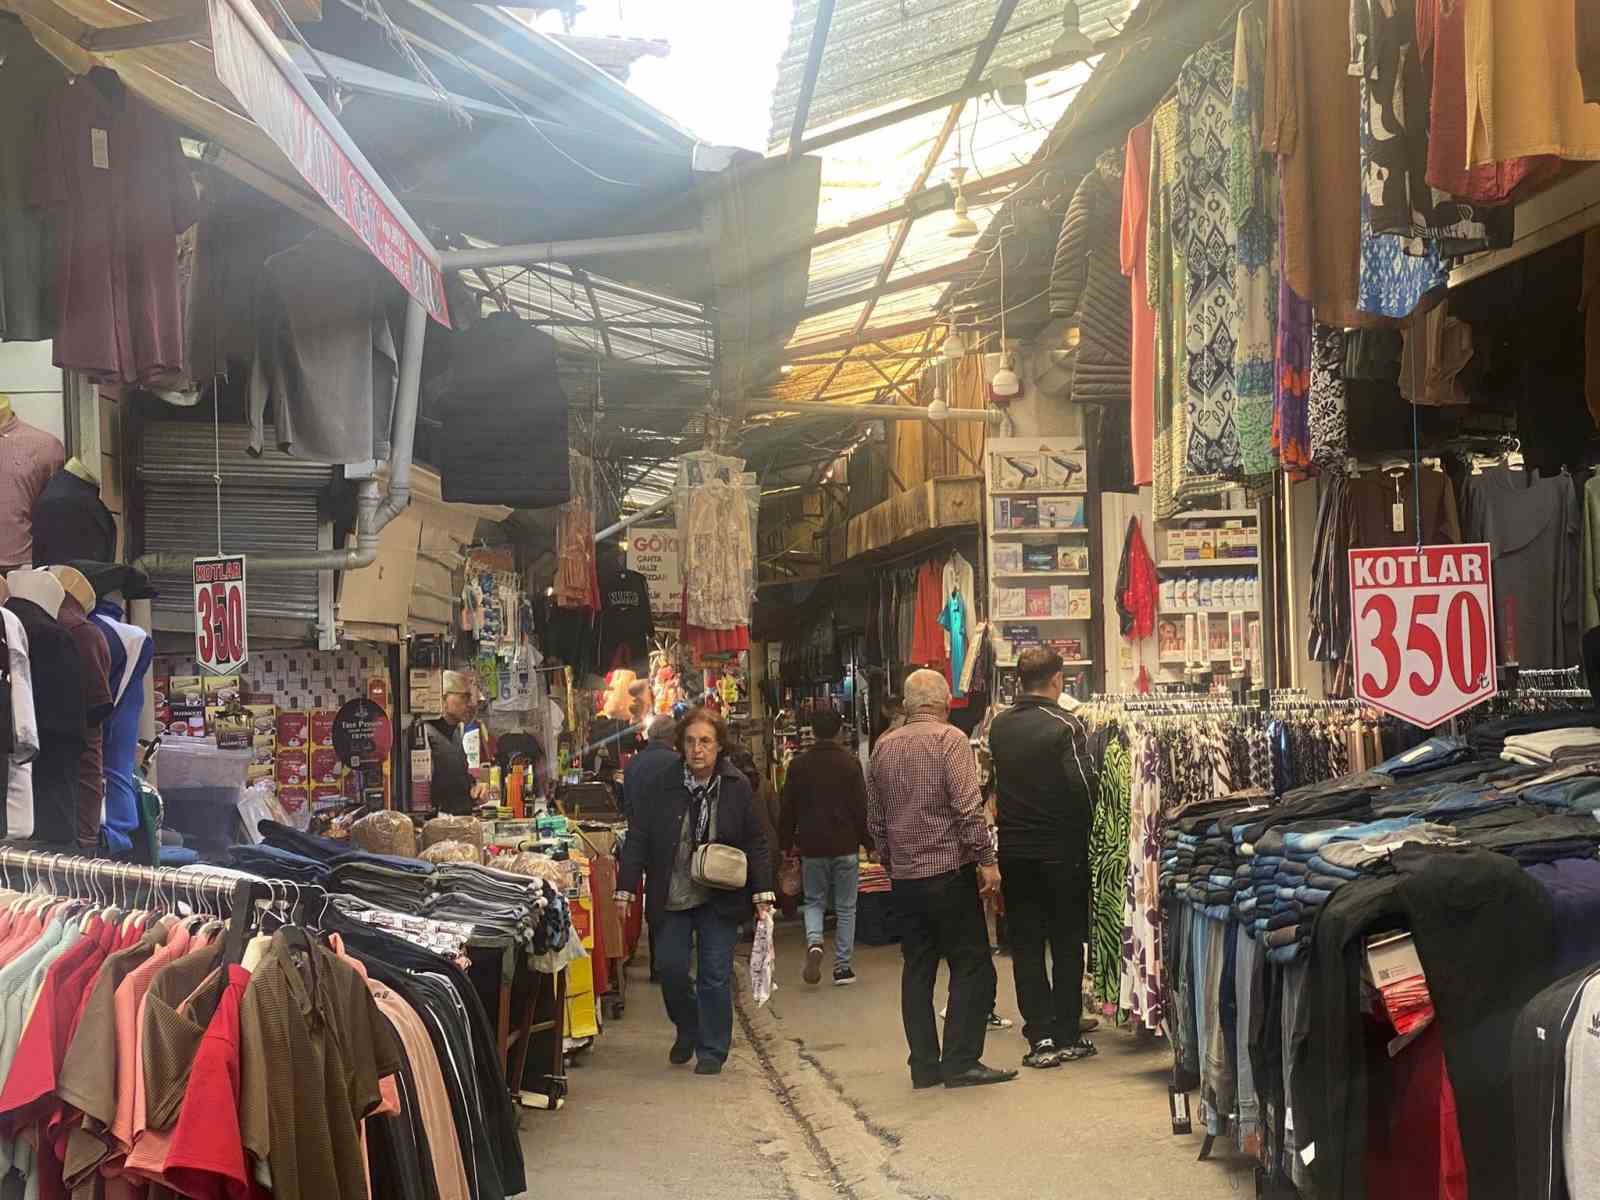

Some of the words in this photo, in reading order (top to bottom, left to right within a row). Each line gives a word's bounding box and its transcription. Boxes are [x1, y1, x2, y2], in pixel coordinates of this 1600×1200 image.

[196, 562, 242, 582] KOTLAR
[1353, 553, 1484, 587] KOTLAR
[198, 582, 244, 664] 350
